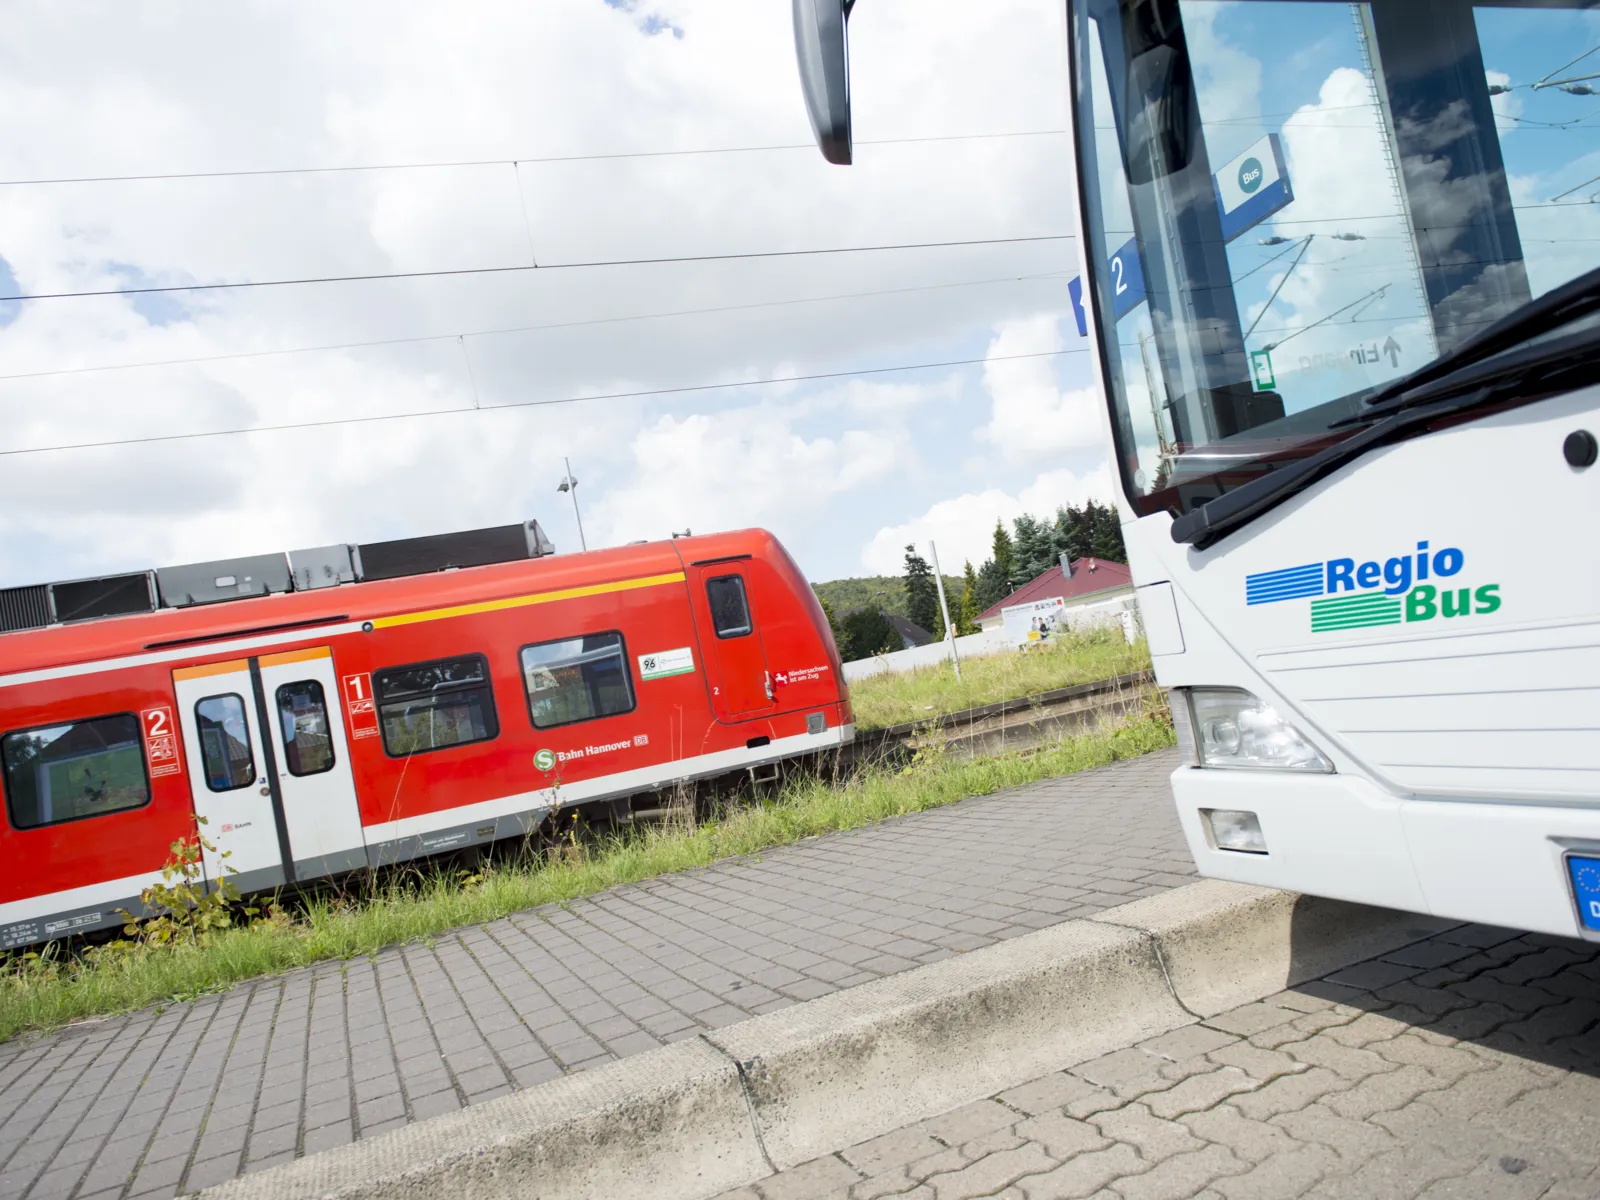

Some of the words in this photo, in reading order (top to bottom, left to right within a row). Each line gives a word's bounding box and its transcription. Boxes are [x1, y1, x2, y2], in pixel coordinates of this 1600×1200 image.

[1242, 168, 1260, 185] Bus
[1111, 256, 1128, 296] 2
[1326, 540, 1464, 596] Regio
[1405, 584, 1502, 623] Bus
[643, 658, 656, 670] 96
[788, 665, 828, 677] Niedersachsen
[349, 676, 364, 700] 1
[713, 686, 720, 695] 2
[147, 710, 168, 736] 2
[558, 749, 584, 762] Bahn
[585, 740, 632, 756] Hannover
[634, 735, 648, 746] DB
